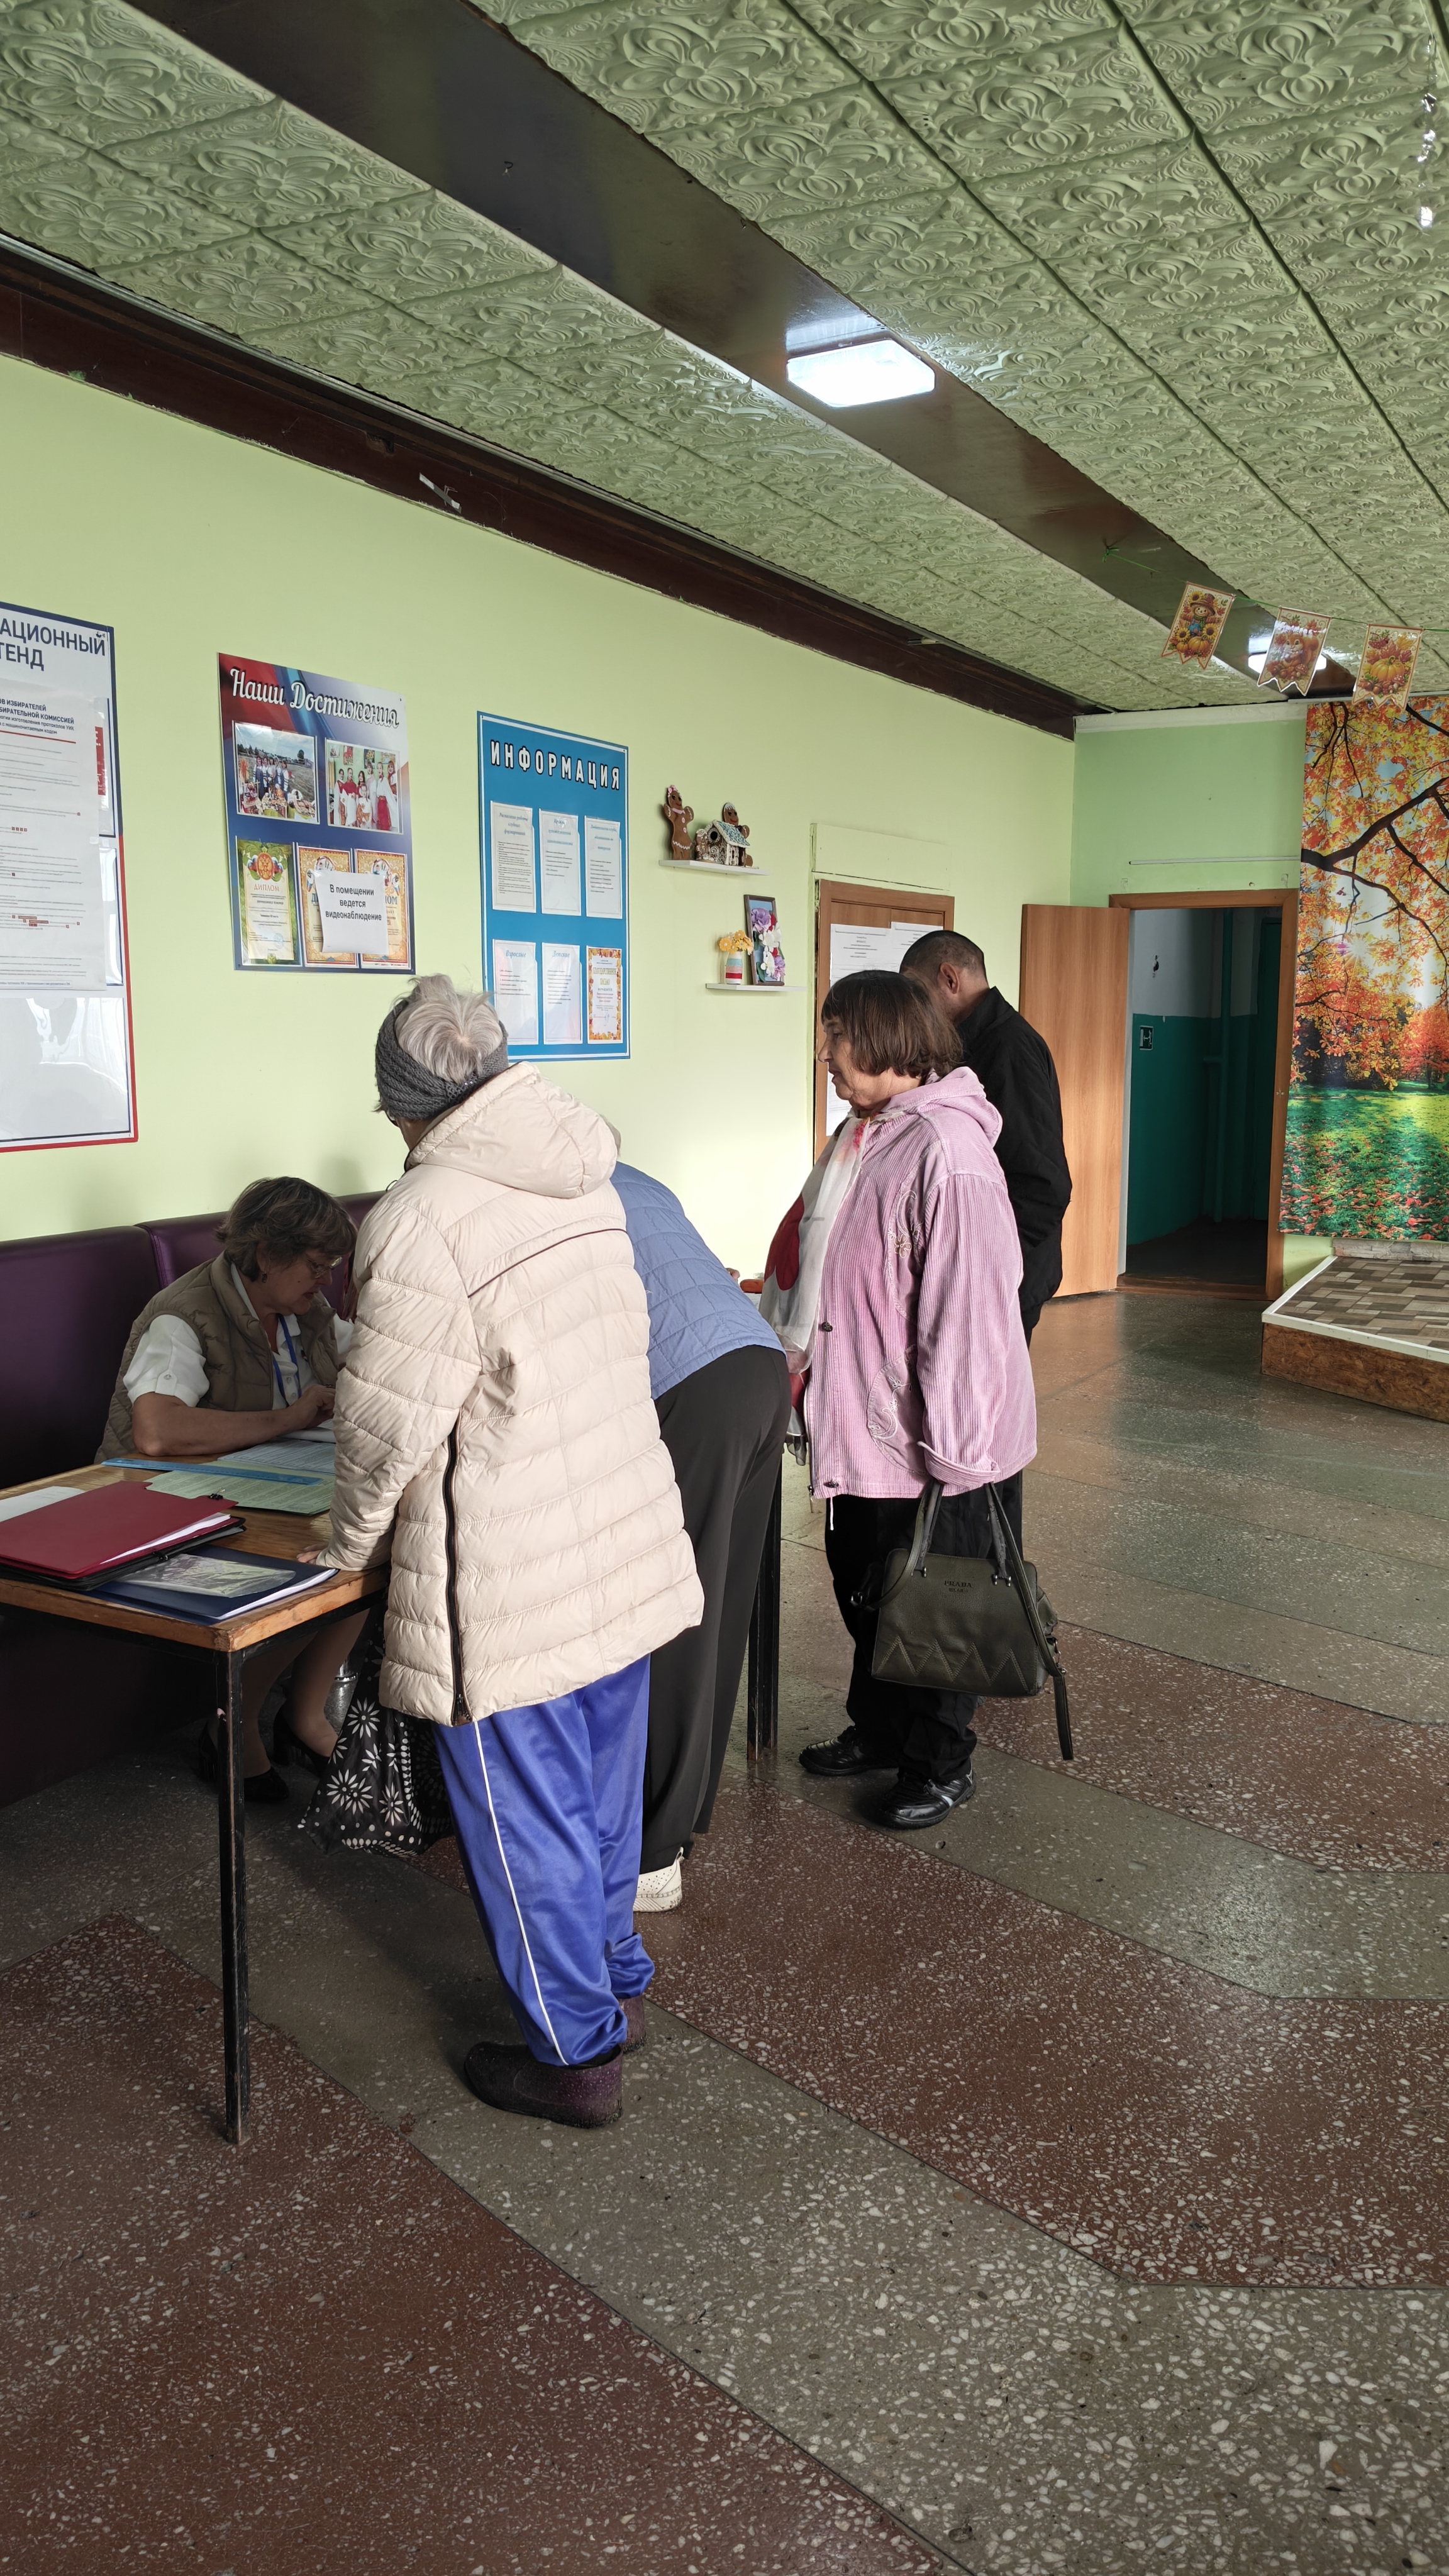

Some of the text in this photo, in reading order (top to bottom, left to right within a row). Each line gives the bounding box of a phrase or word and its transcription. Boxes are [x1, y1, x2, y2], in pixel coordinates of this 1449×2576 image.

[230, 668, 399, 728] Наши Достижения
[7, 699, 47, 711] ИЗБИРАТЕЛЕЙ
[40, 713, 74, 724] КОМИССИЕЙ
[491, 740, 620, 790] ИНФОРМАЦИЯ
[253, 884, 279, 892] ДИПЛОМ
[330, 884, 374, 896] В помещении
[340, 899, 366, 908] ведется
[325, 911, 382, 921] видеонаблюдение
